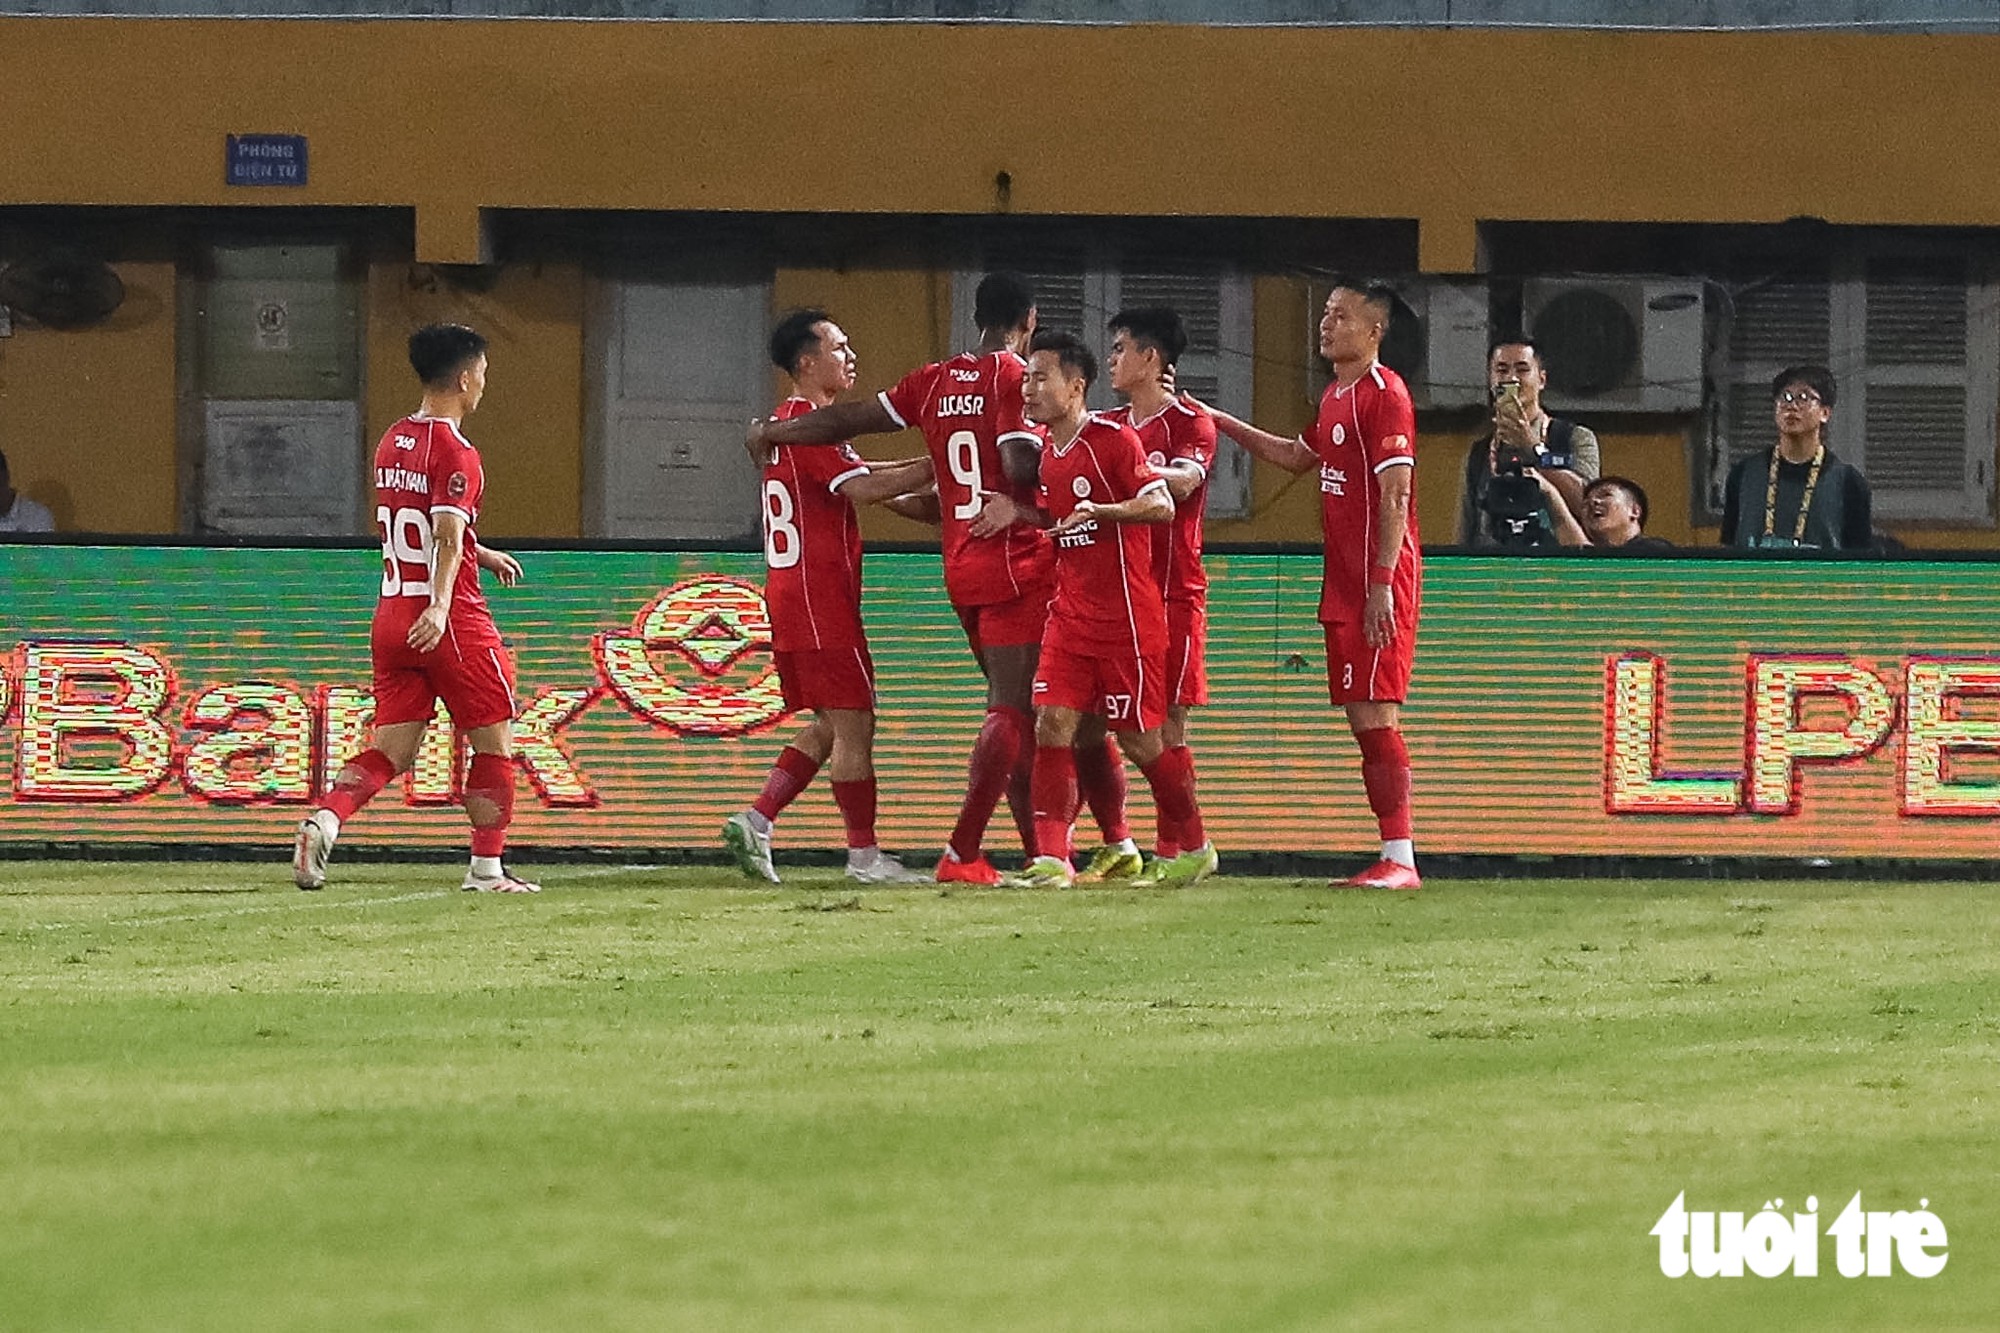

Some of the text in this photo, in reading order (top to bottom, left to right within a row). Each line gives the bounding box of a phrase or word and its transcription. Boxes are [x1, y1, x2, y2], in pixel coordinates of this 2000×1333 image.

[947, 430, 983, 520] 9
[762, 480, 800, 568] 8
[0, 640, 598, 806] Bank
[1105, 694, 1132, 720] 97
